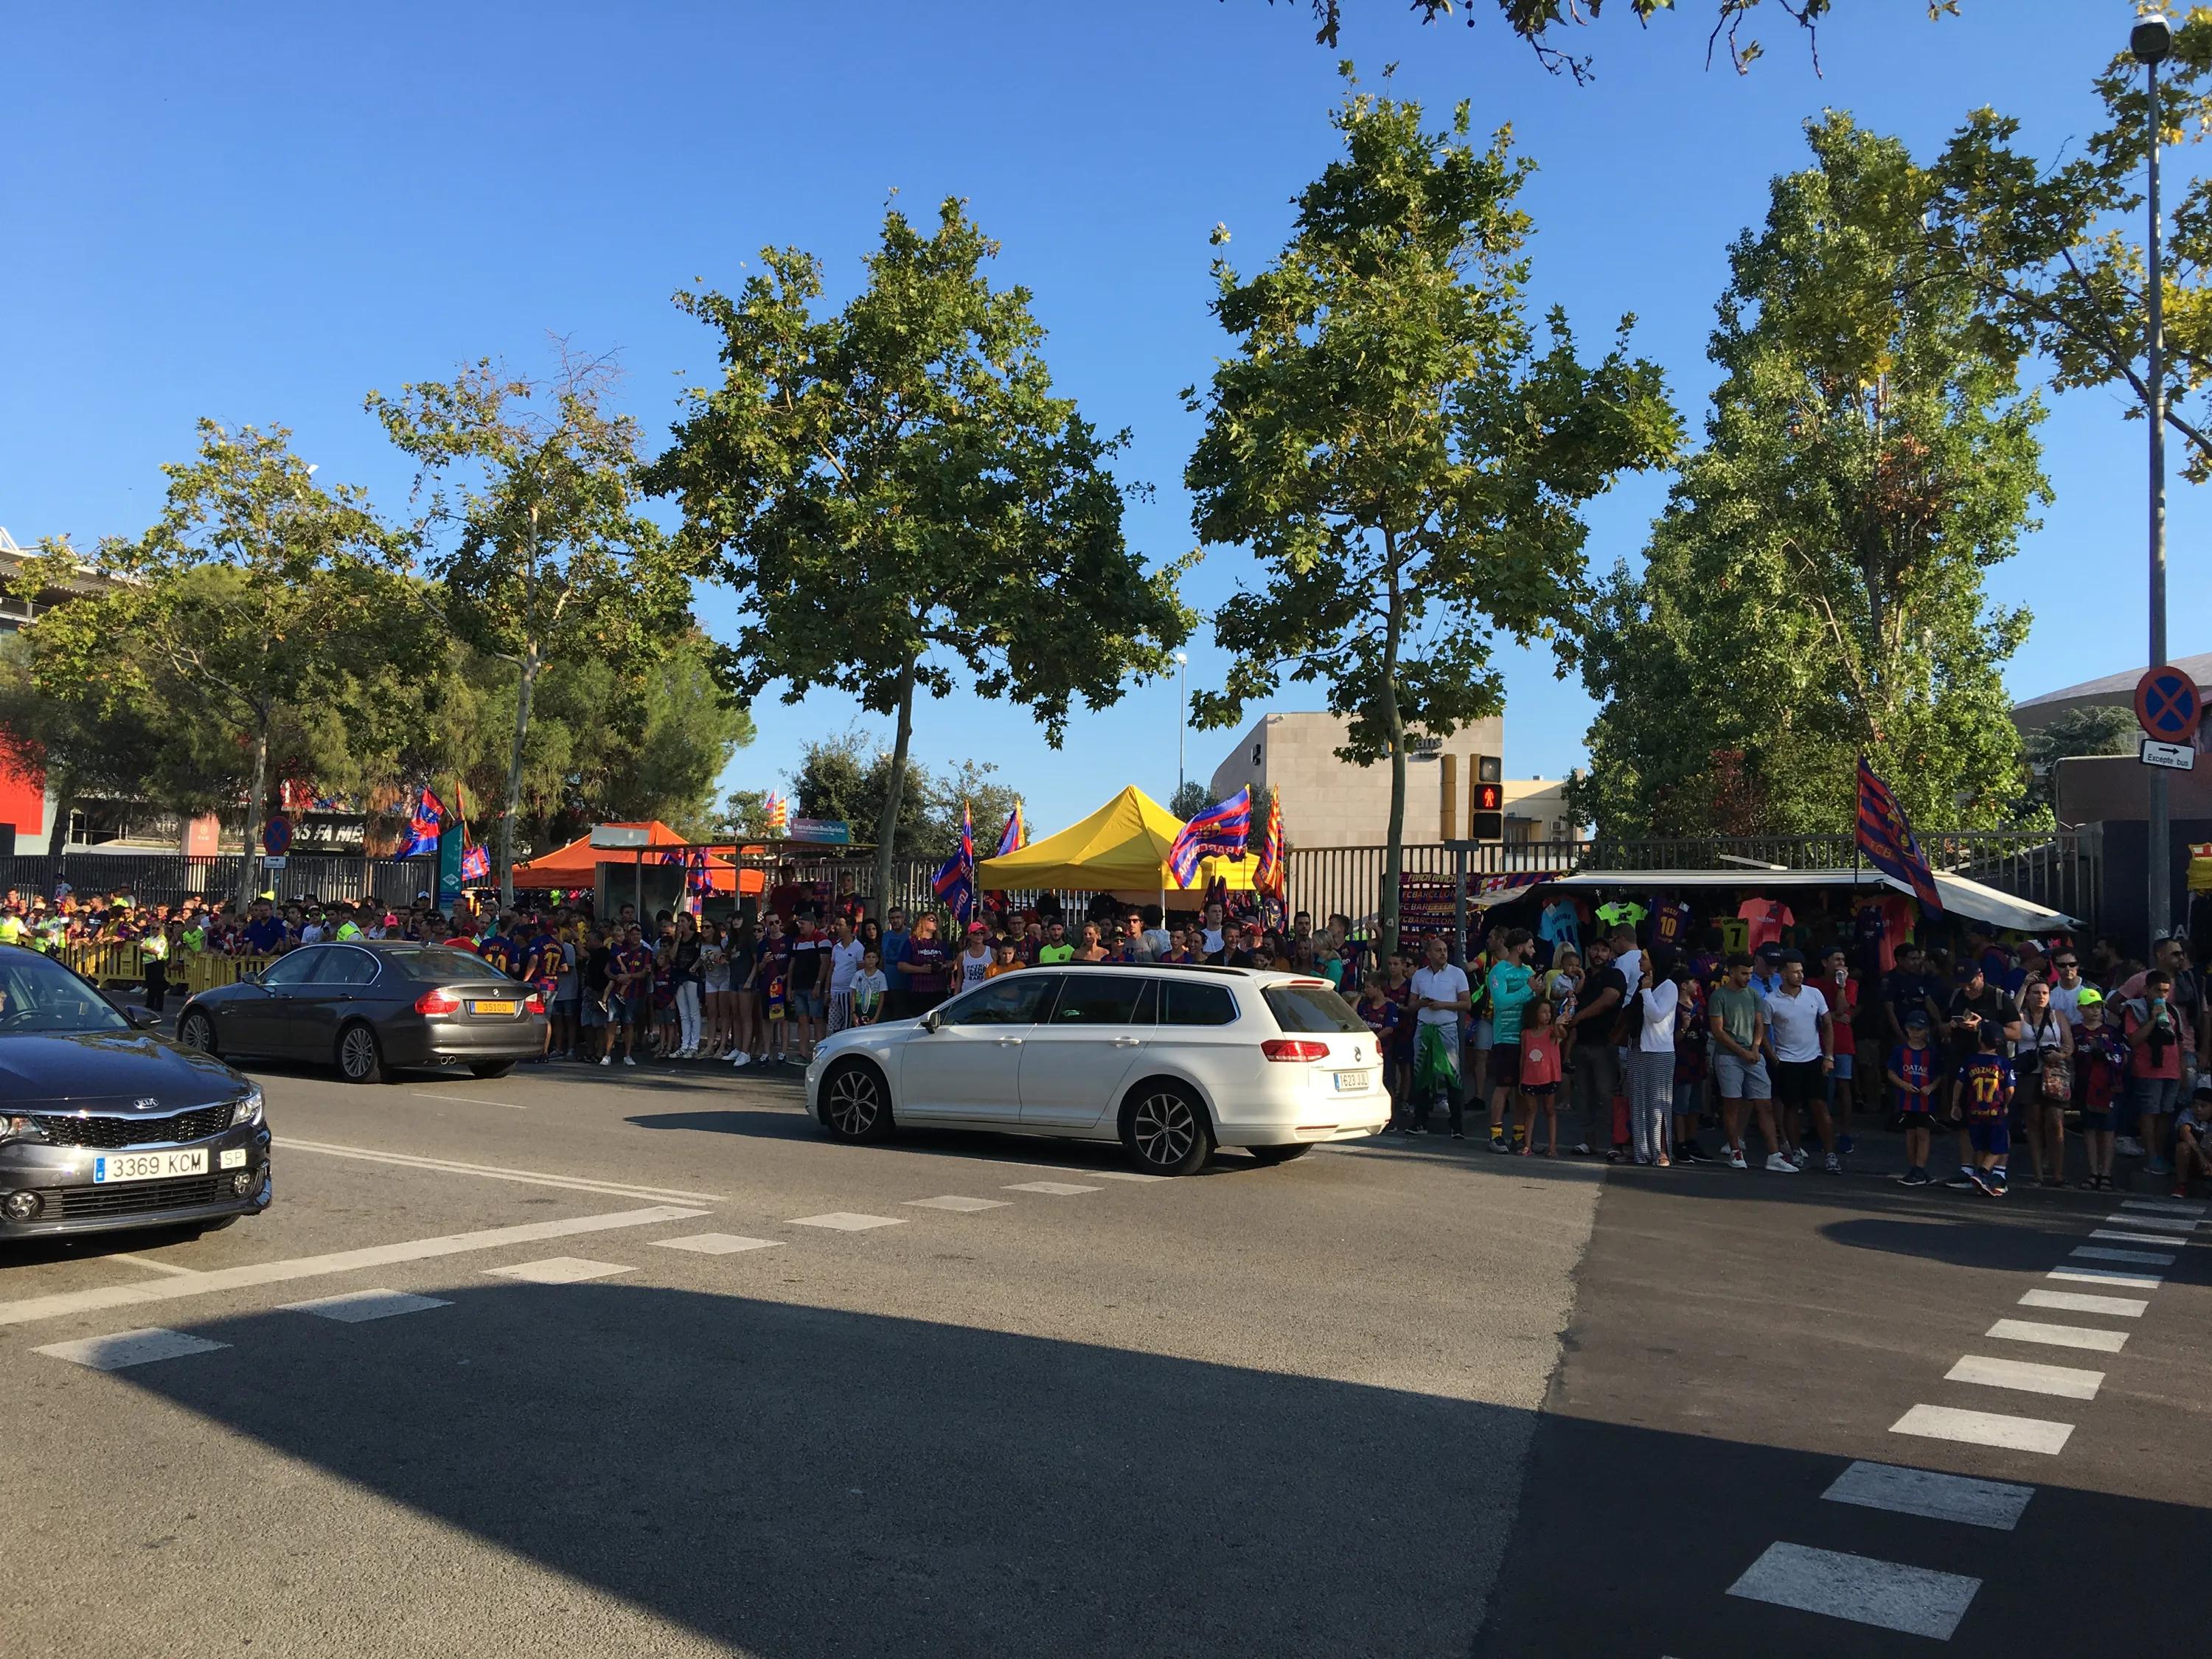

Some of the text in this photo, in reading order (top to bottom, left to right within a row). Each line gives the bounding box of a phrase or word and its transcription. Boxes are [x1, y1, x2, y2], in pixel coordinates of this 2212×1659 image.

[2147, 754, 2189, 767] Excepte bus
[313, 824, 333, 841] FA
[335, 822, 365, 843] MÉ
[1660, 916, 1677, 937] 10
[1730, 928, 1741, 947] 7
[543, 951, 561, 975] 17
[483, 1003, 507, 1012] 35100
[1902, 1064, 1928, 1073] QATAR
[1972, 1077, 2000, 1103] 17
[113, 1152, 201, 1178] 3369 KCM
[225, 1151, 243, 1166] SP
